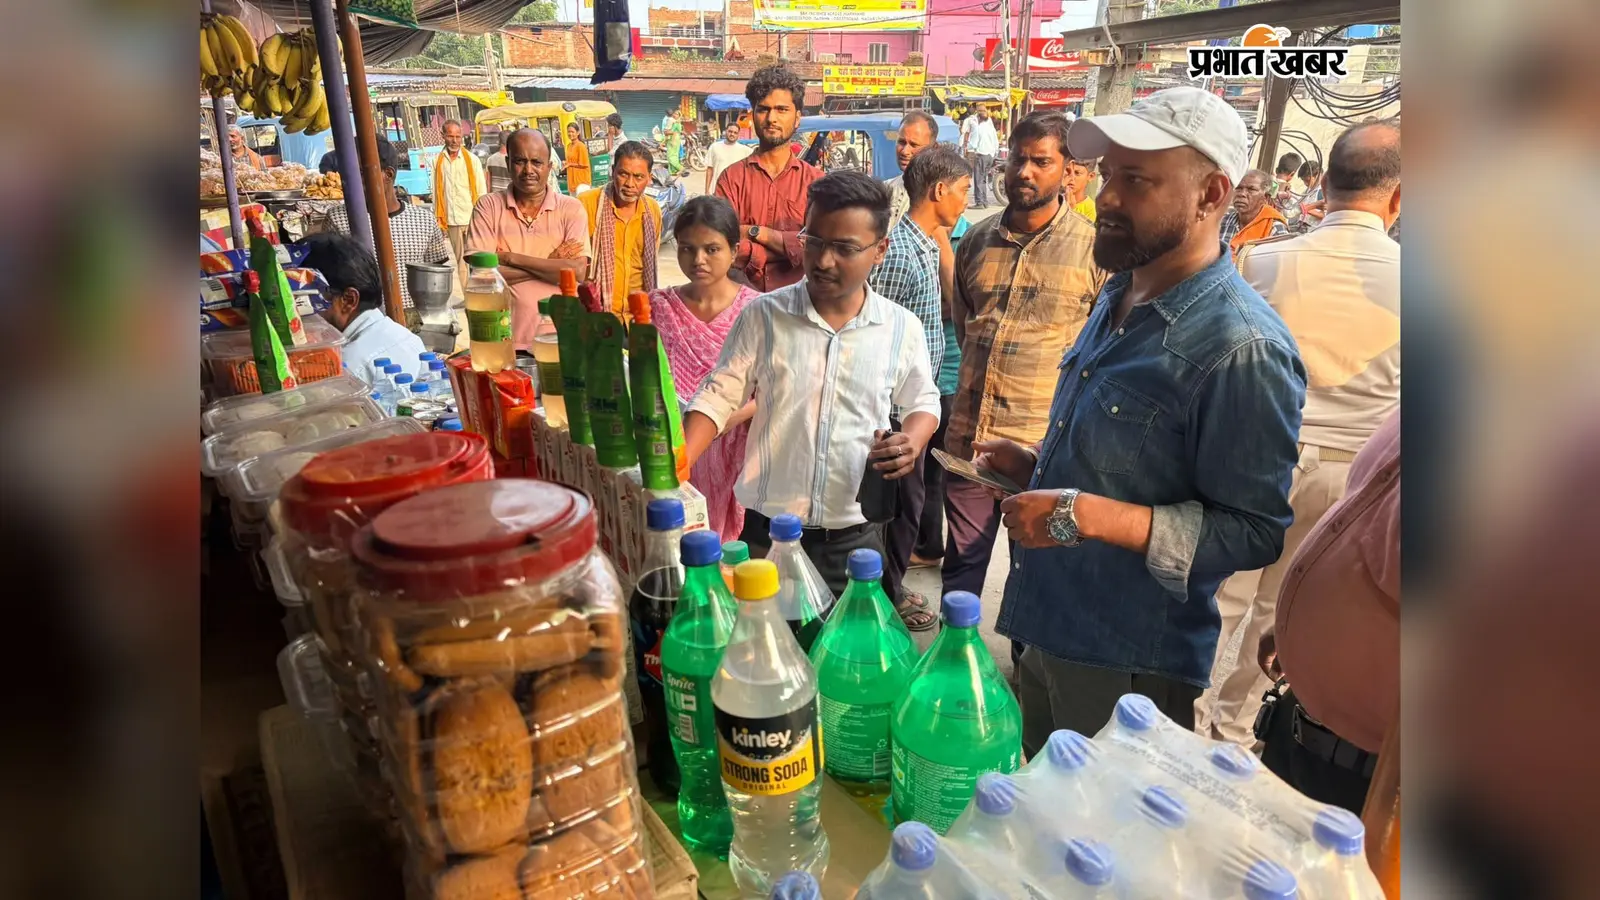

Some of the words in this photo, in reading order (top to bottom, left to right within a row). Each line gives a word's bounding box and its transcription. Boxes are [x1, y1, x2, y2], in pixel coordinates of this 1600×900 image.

[667, 673, 695, 691] Sprite
[731, 727, 792, 749] kinley
[723, 757, 770, 783] STRONG
[773, 756, 808, 782] SODA
[743, 782, 788, 792] ORIGINAL
